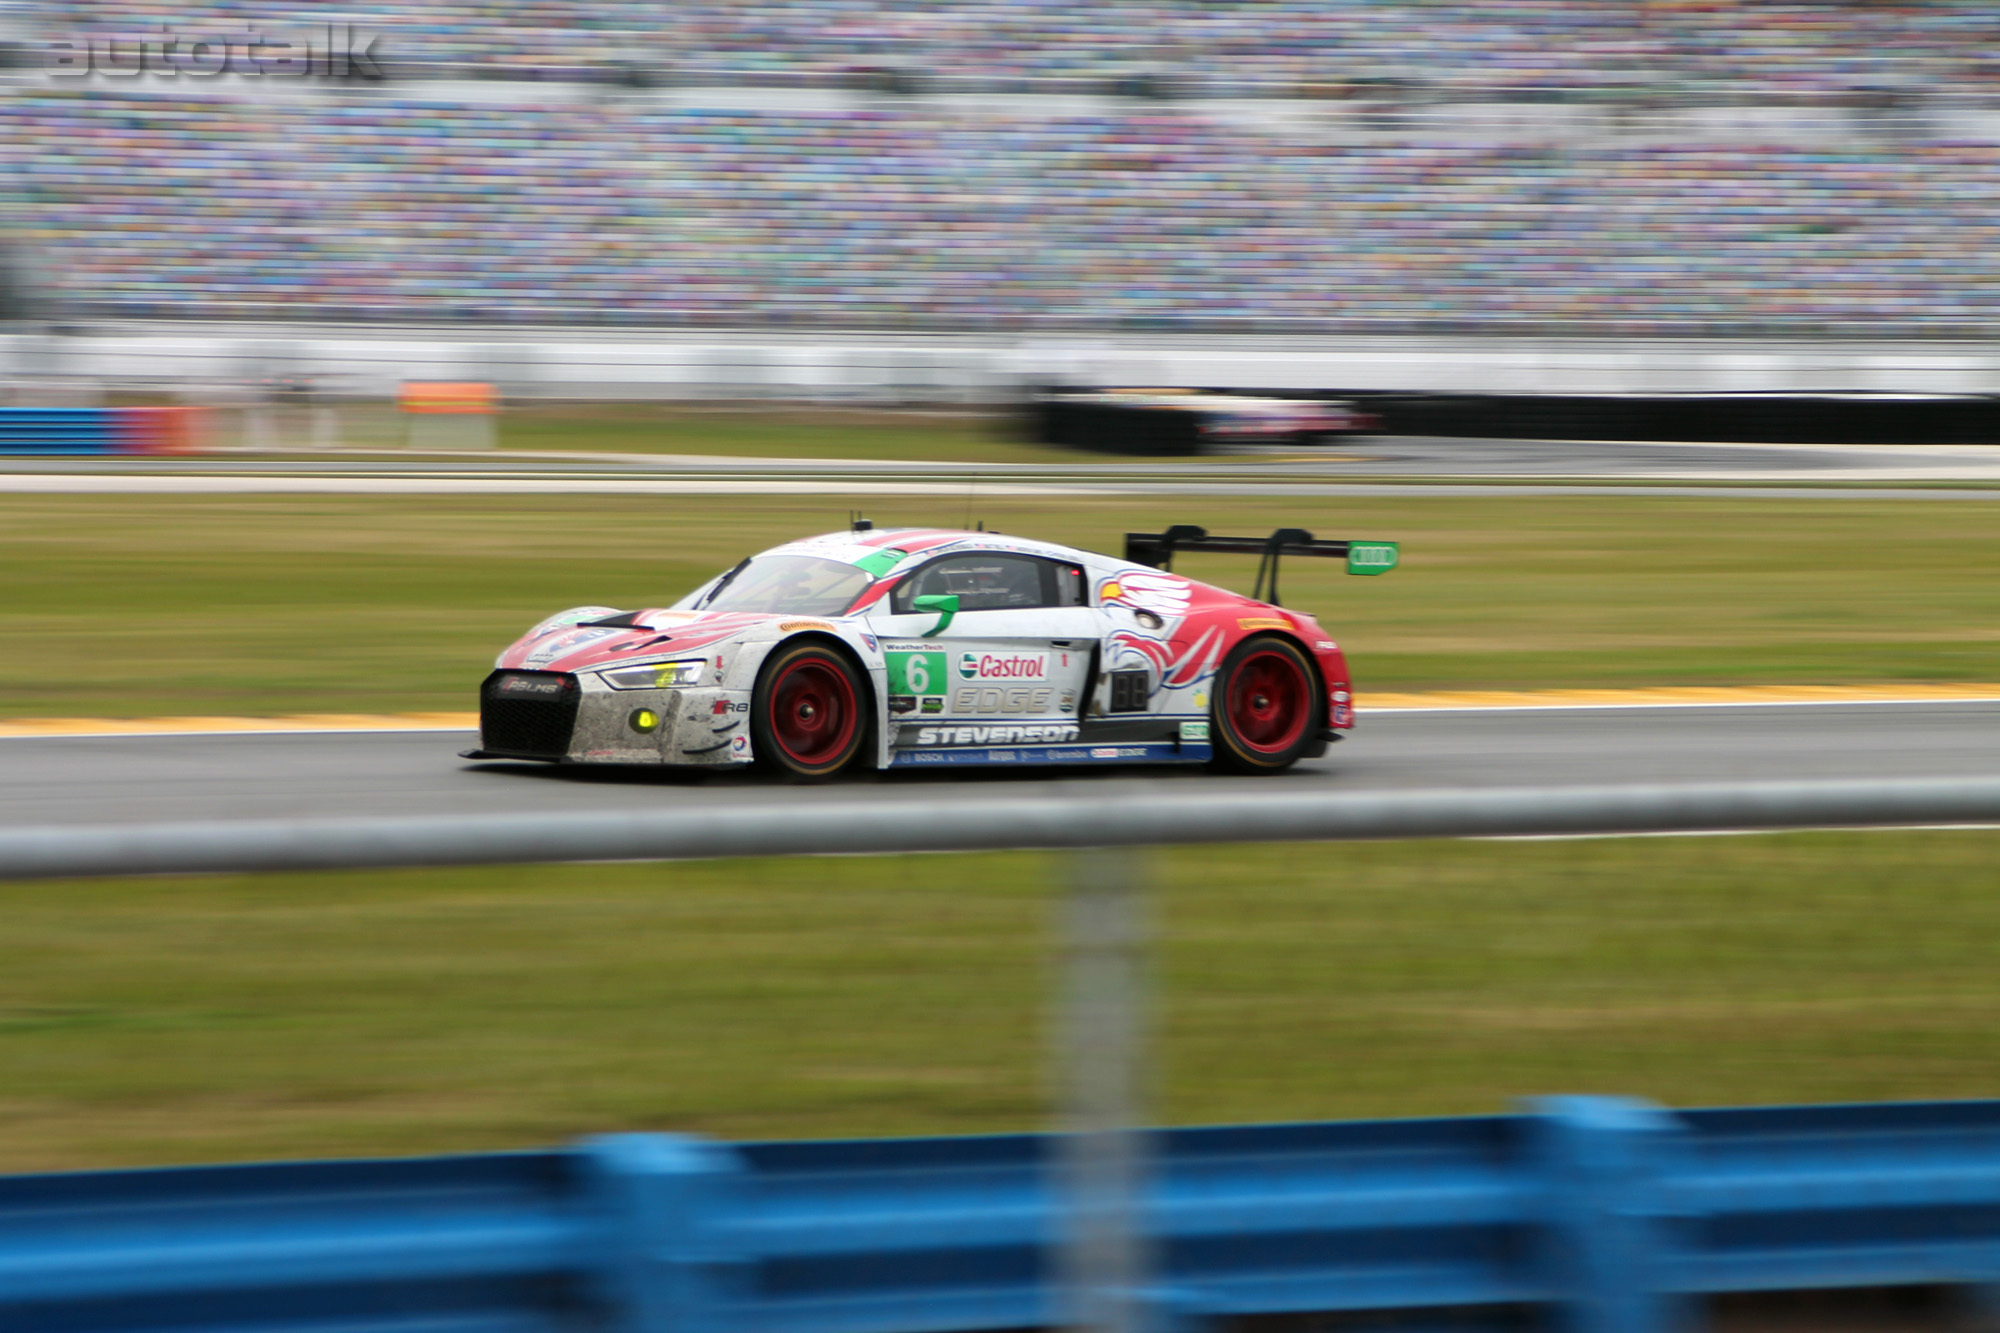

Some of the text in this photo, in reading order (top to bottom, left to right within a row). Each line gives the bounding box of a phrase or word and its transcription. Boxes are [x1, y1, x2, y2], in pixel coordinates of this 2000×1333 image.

[886, 643, 944, 651] WeatherTech
[906, 654, 930, 693] 6
[979, 655, 1044, 678] Castrol
[722, 702, 749, 712] R8
[951, 687, 1054, 714] EDGE
[914, 752, 944, 762] BOSCH
